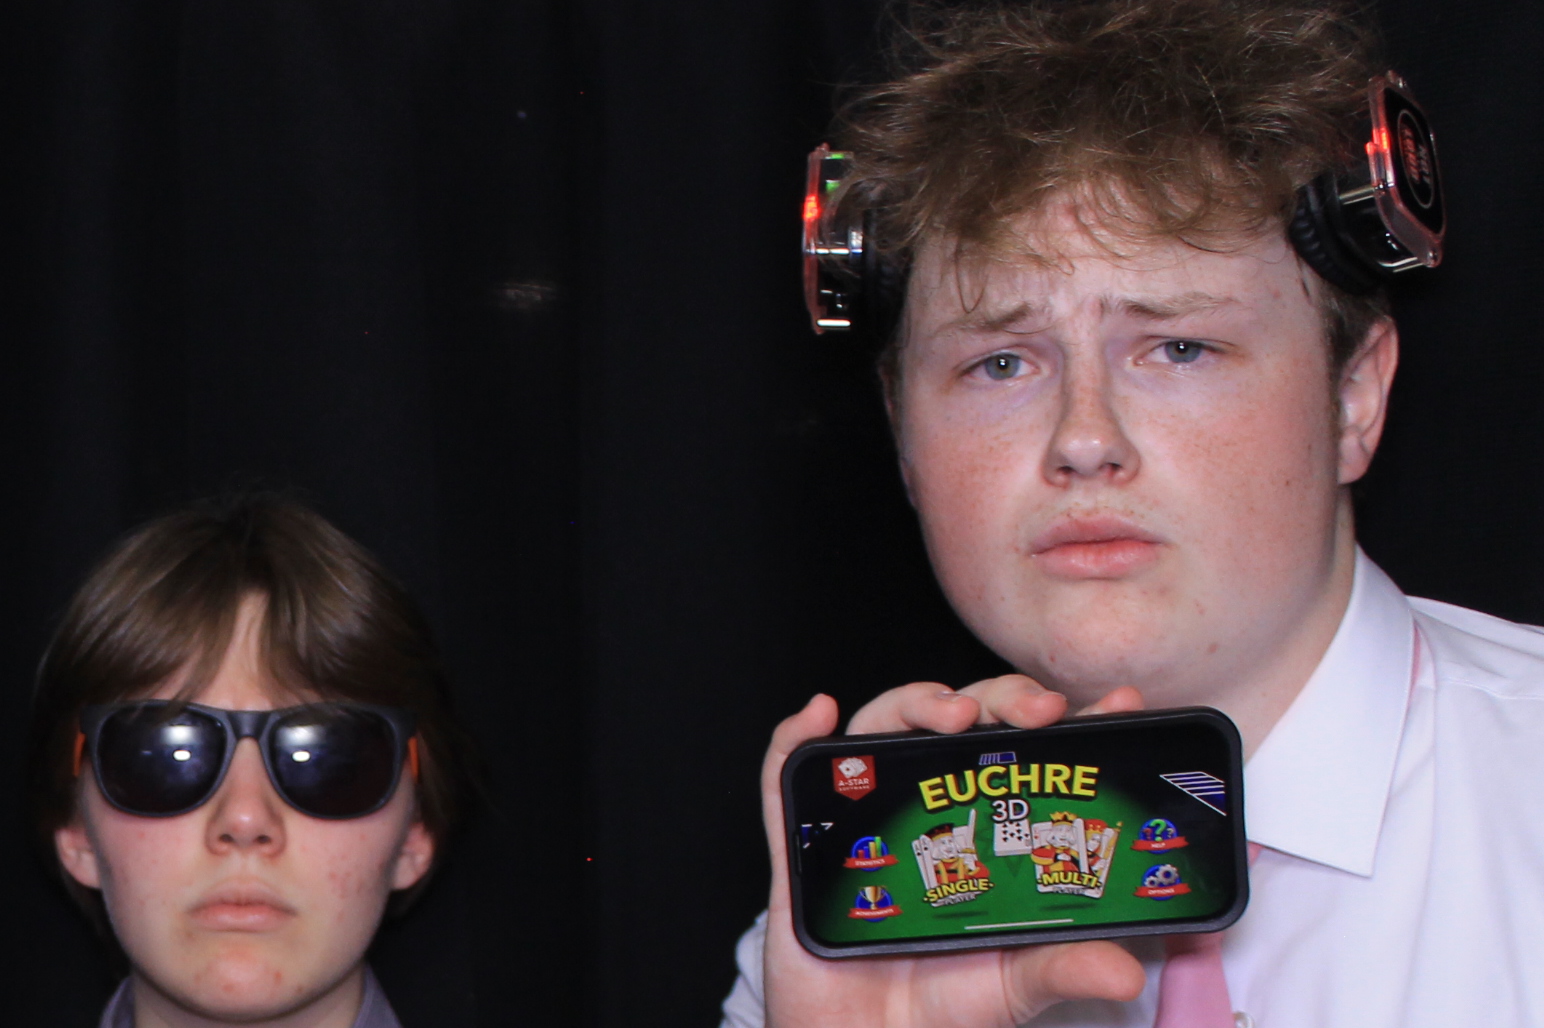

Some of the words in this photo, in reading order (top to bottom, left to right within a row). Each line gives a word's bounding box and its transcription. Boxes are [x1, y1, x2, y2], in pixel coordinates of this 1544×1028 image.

[918, 763, 1099, 810] EUCHRE
[992, 799, 1029, 821] 3D
[926, 878, 989, 902] SINGLE
[1042, 871, 1098, 887] MULTI
